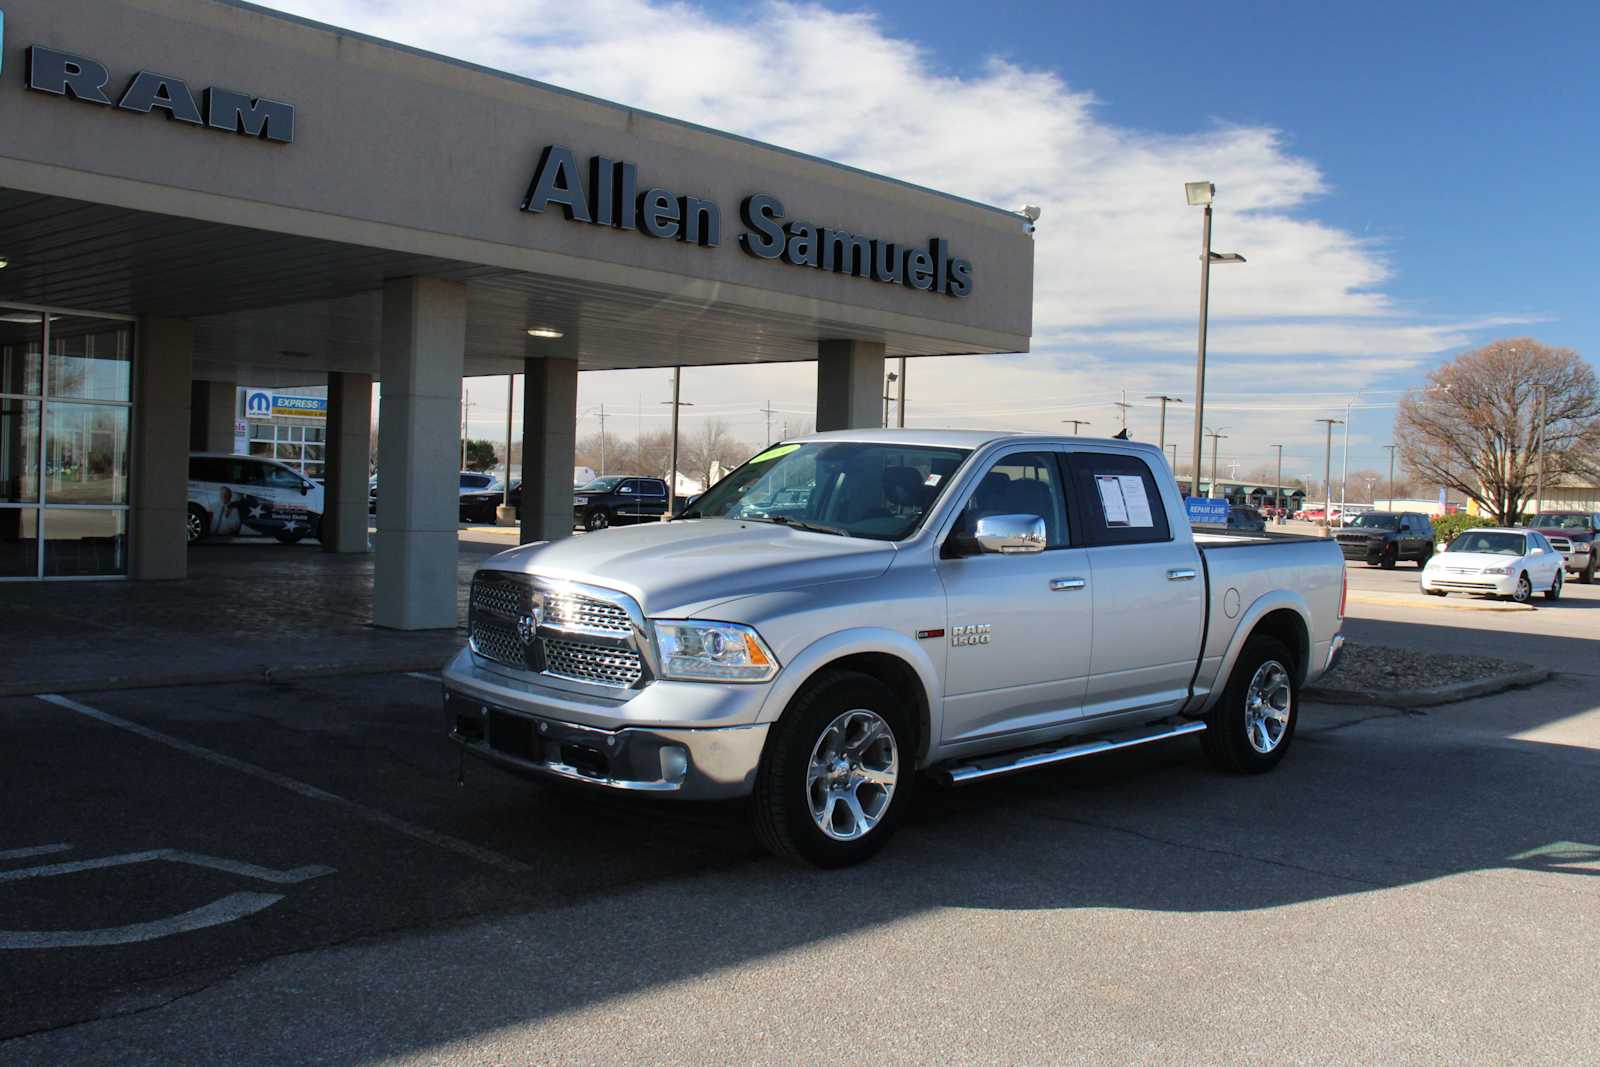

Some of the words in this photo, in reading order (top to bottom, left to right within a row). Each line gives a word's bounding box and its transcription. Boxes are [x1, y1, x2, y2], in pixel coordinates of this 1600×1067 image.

[26, 45, 295, 144] RAM
[520, 143, 721, 248] Allen
[738, 192, 974, 298] Samuels
[277, 398, 320, 409] EXPRESS
[951, 624, 992, 637] RAM
[952, 635, 992, 647] 1500
